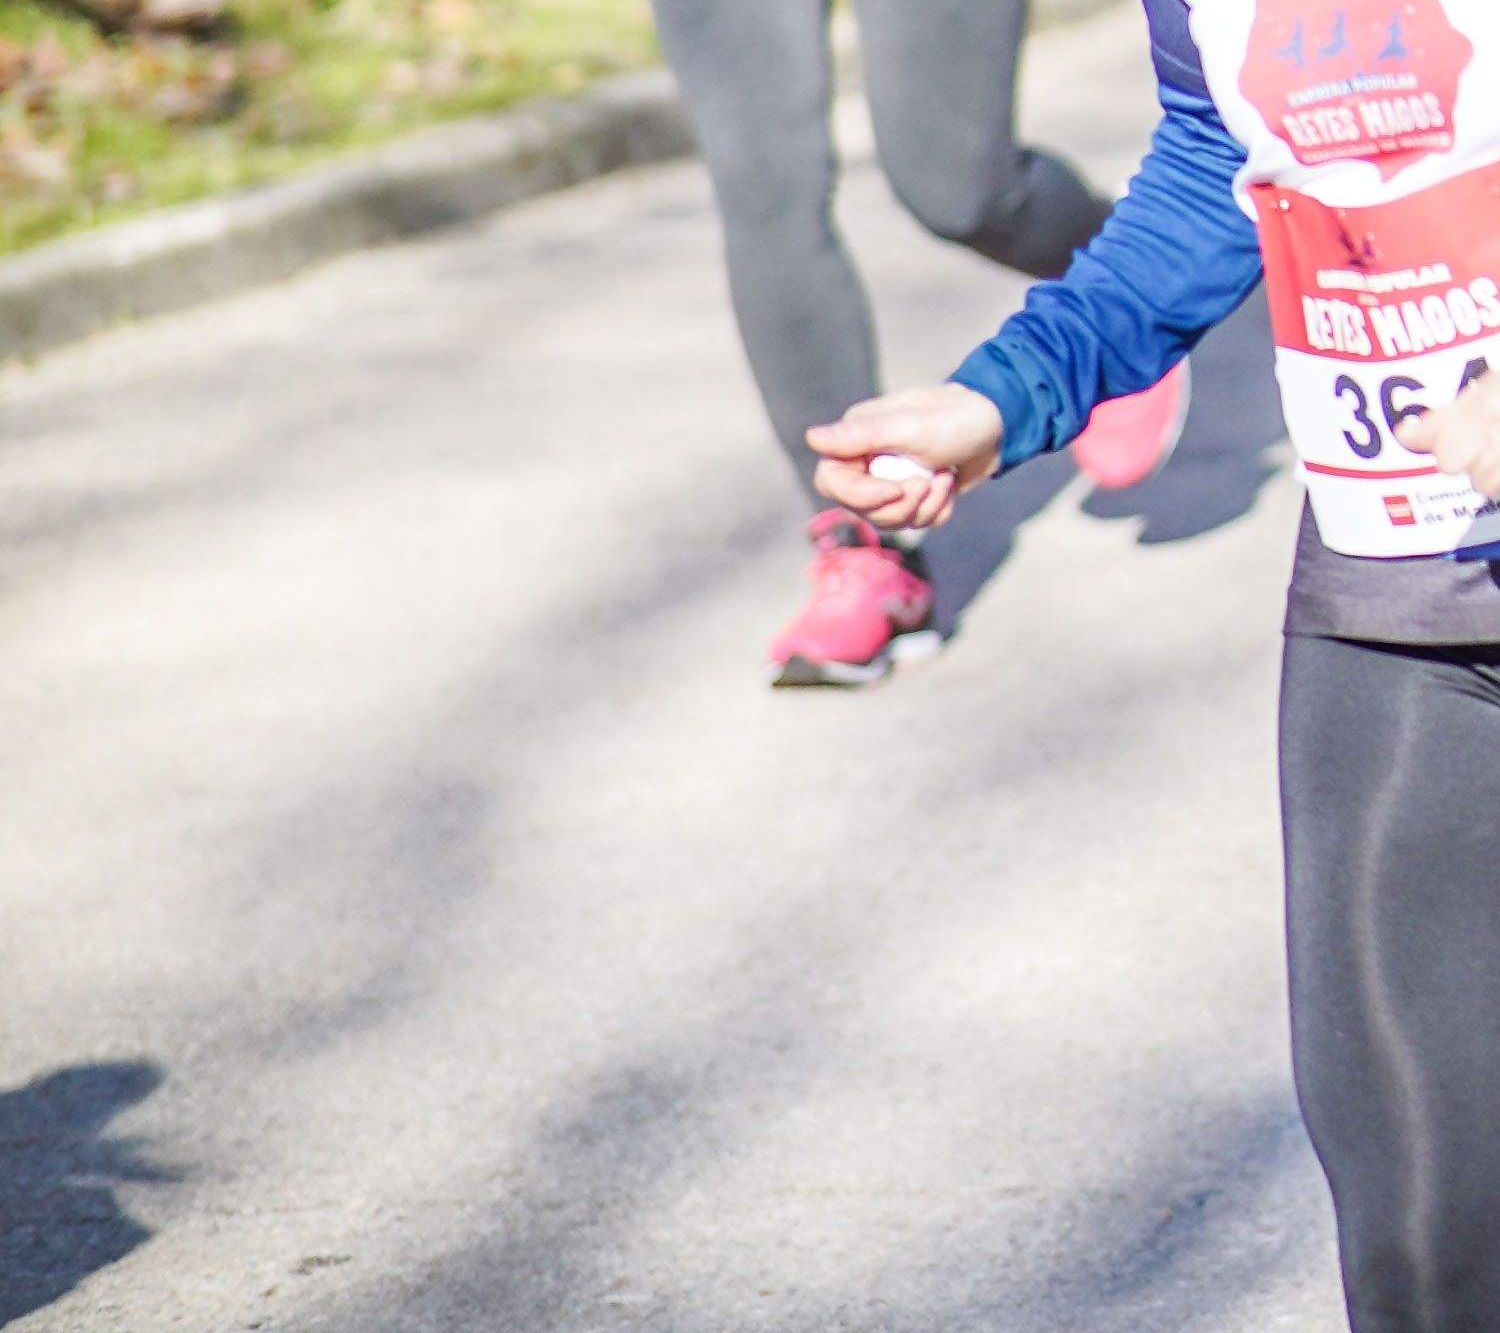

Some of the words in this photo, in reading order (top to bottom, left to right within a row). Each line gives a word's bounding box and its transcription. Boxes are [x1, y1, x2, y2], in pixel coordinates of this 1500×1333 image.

[1281, 106, 1360, 147] REYES
[1359, 91, 1446, 139] MAGOS
[1334, 356, 1489, 459] 36
